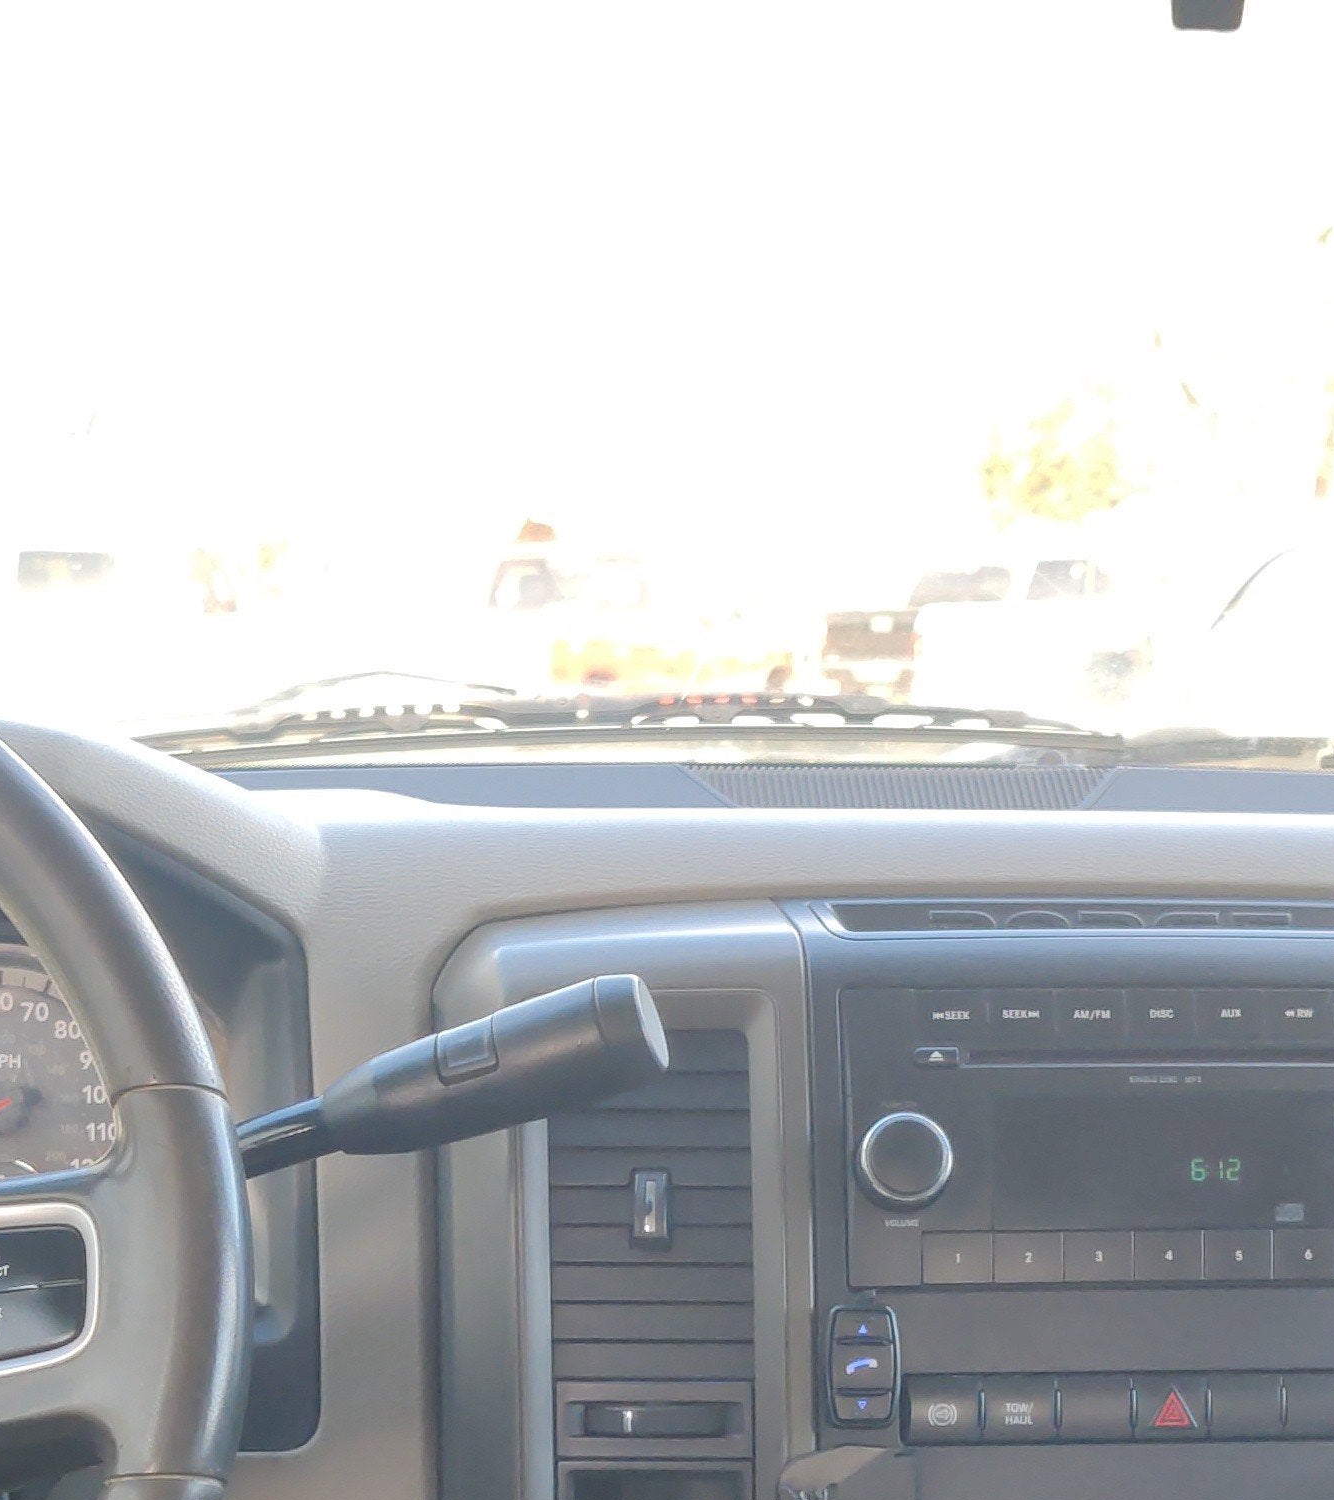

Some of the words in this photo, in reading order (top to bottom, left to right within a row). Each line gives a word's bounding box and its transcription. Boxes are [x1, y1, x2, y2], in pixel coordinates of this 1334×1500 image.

[20, 1002, 50, 1022] 70
[944, 1010, 971, 1021] SEEK
[1002, 1009, 1028, 1019] SEEK
[1073, 1009, 1112, 1021] AM/FM
[1149, 1008, 1175, 1020] DISC
[1220, 1008, 1242, 1019] AUX
[1296, 1008, 1314, 1019] RW
[54, 1020, 82, 1040] 80
[1024, 1251, 1033, 1263] 2
[1094, 1250, 1104, 1262] 3
[1164, 1249, 1174, 1261] 4
[1234, 1249, 1244, 1261] 5
[1304, 1248, 1314, 1261] 6
[1005, 1401, 1034, 1415] TOW/
[1004, 1415, 1034, 1426] HAUL
